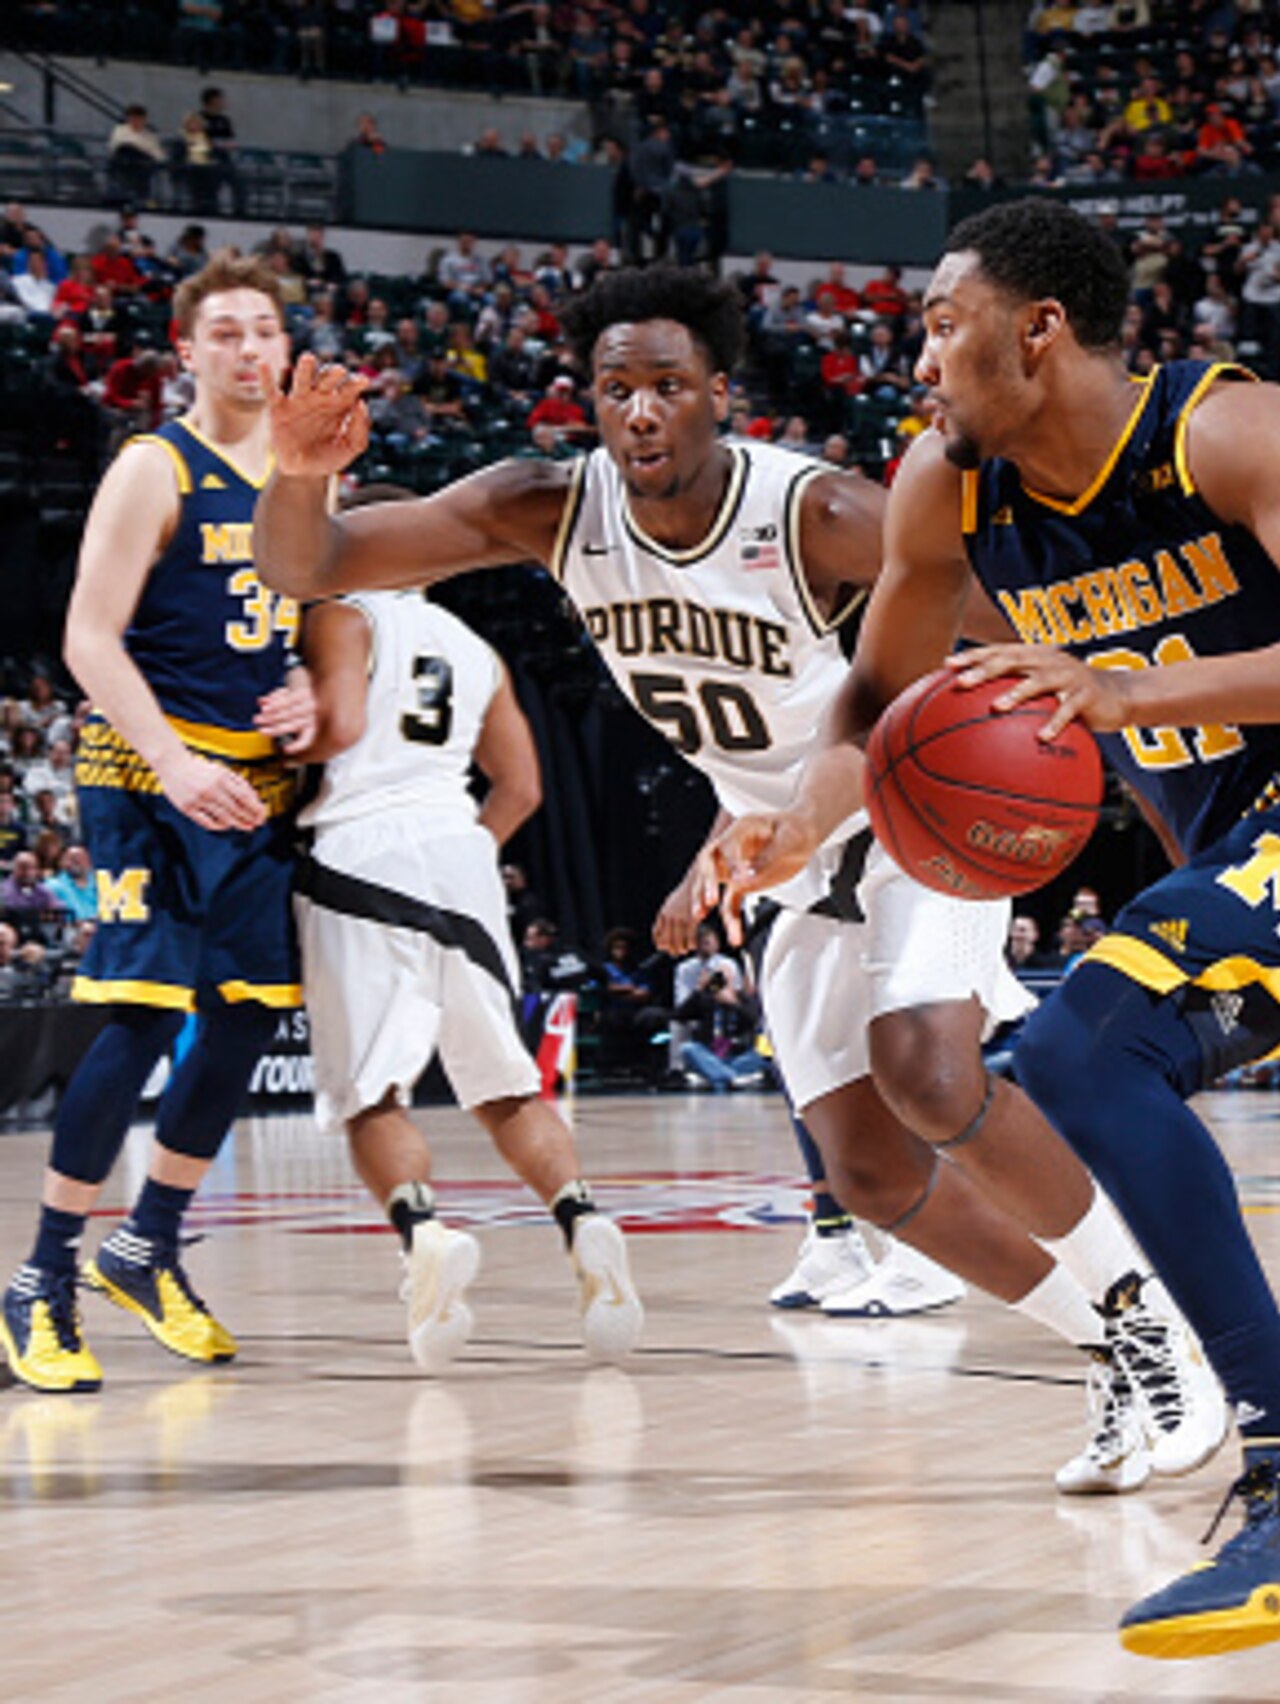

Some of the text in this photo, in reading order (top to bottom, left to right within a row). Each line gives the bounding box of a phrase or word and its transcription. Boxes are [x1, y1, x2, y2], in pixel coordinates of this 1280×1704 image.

[226, 567, 297, 651] 34
[997, 530, 1241, 646] MICHIGAN
[584, 597, 794, 681] PURDUE
[401, 656, 454, 746] 3
[629, 672, 773, 755] 50
[96, 867, 151, 922] M
